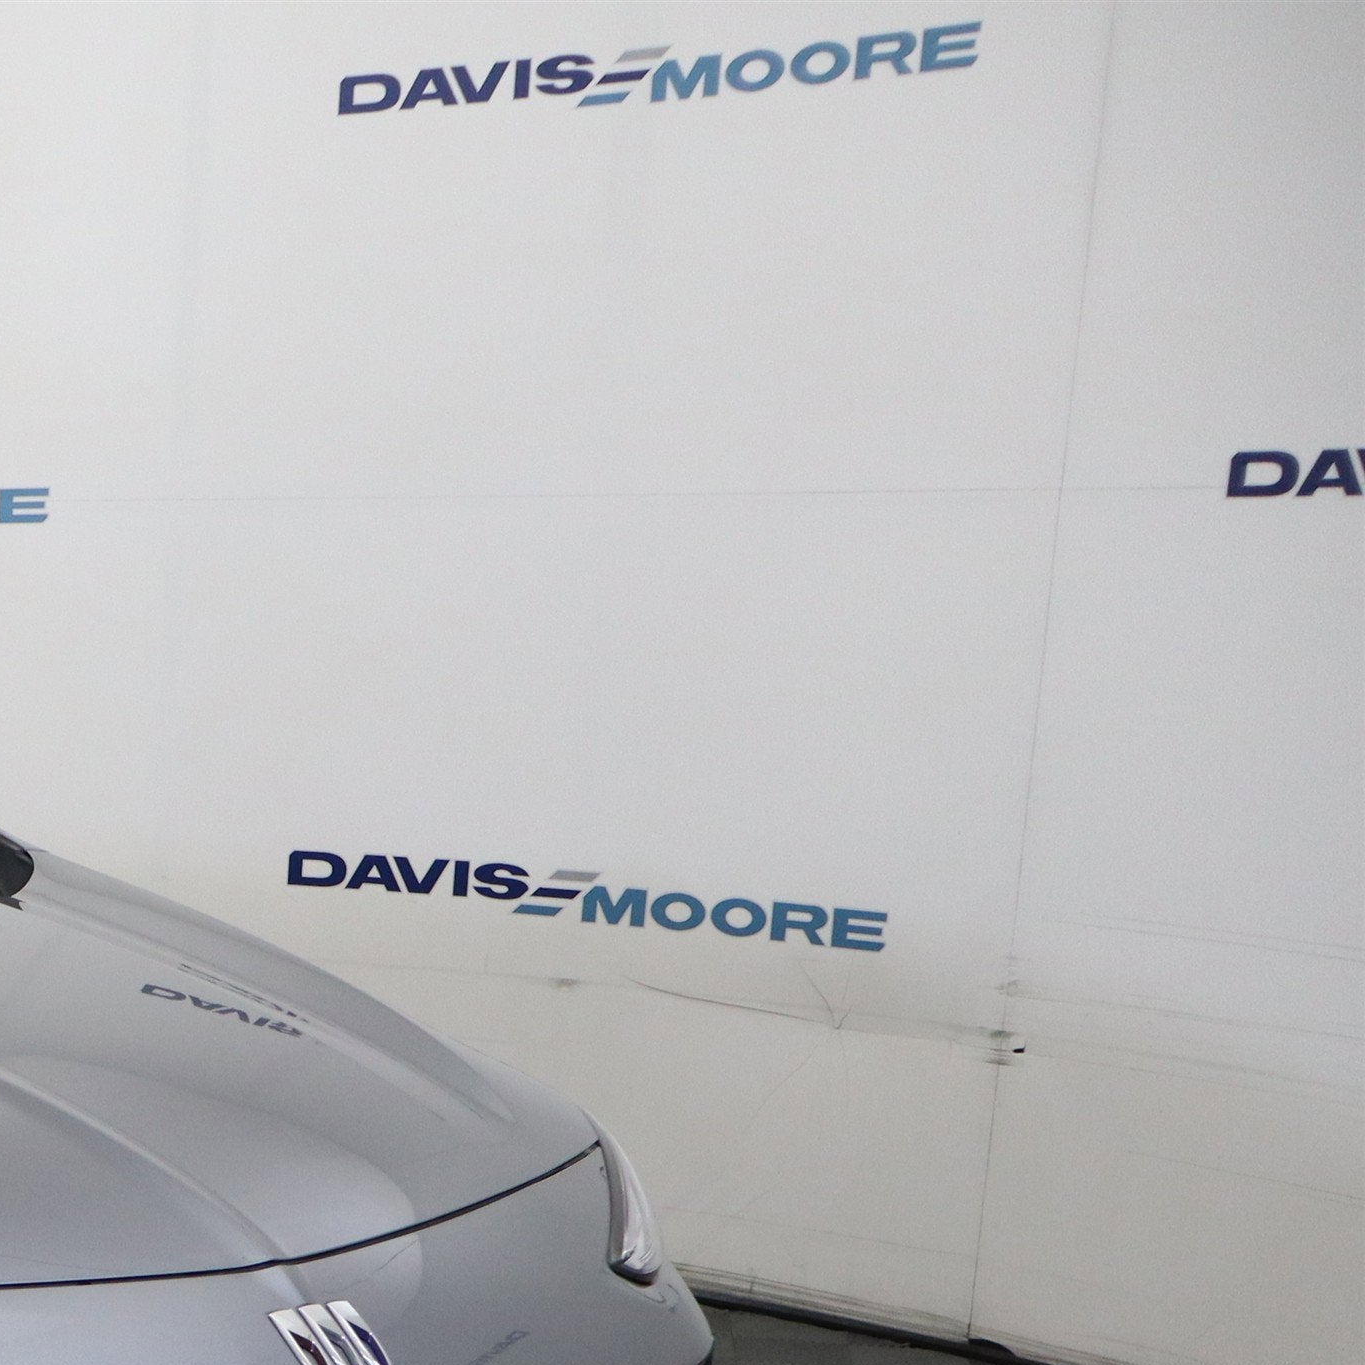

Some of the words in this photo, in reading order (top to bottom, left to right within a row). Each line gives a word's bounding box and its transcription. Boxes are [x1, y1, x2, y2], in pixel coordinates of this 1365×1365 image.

[337, 53, 595, 116] DAVIS
[650, 21, 982, 103] MOORE
[1225, 447, 1365, 499] DA
[286, 849, 531, 901] DAVIS
[580, 885, 888, 953] MOORE
